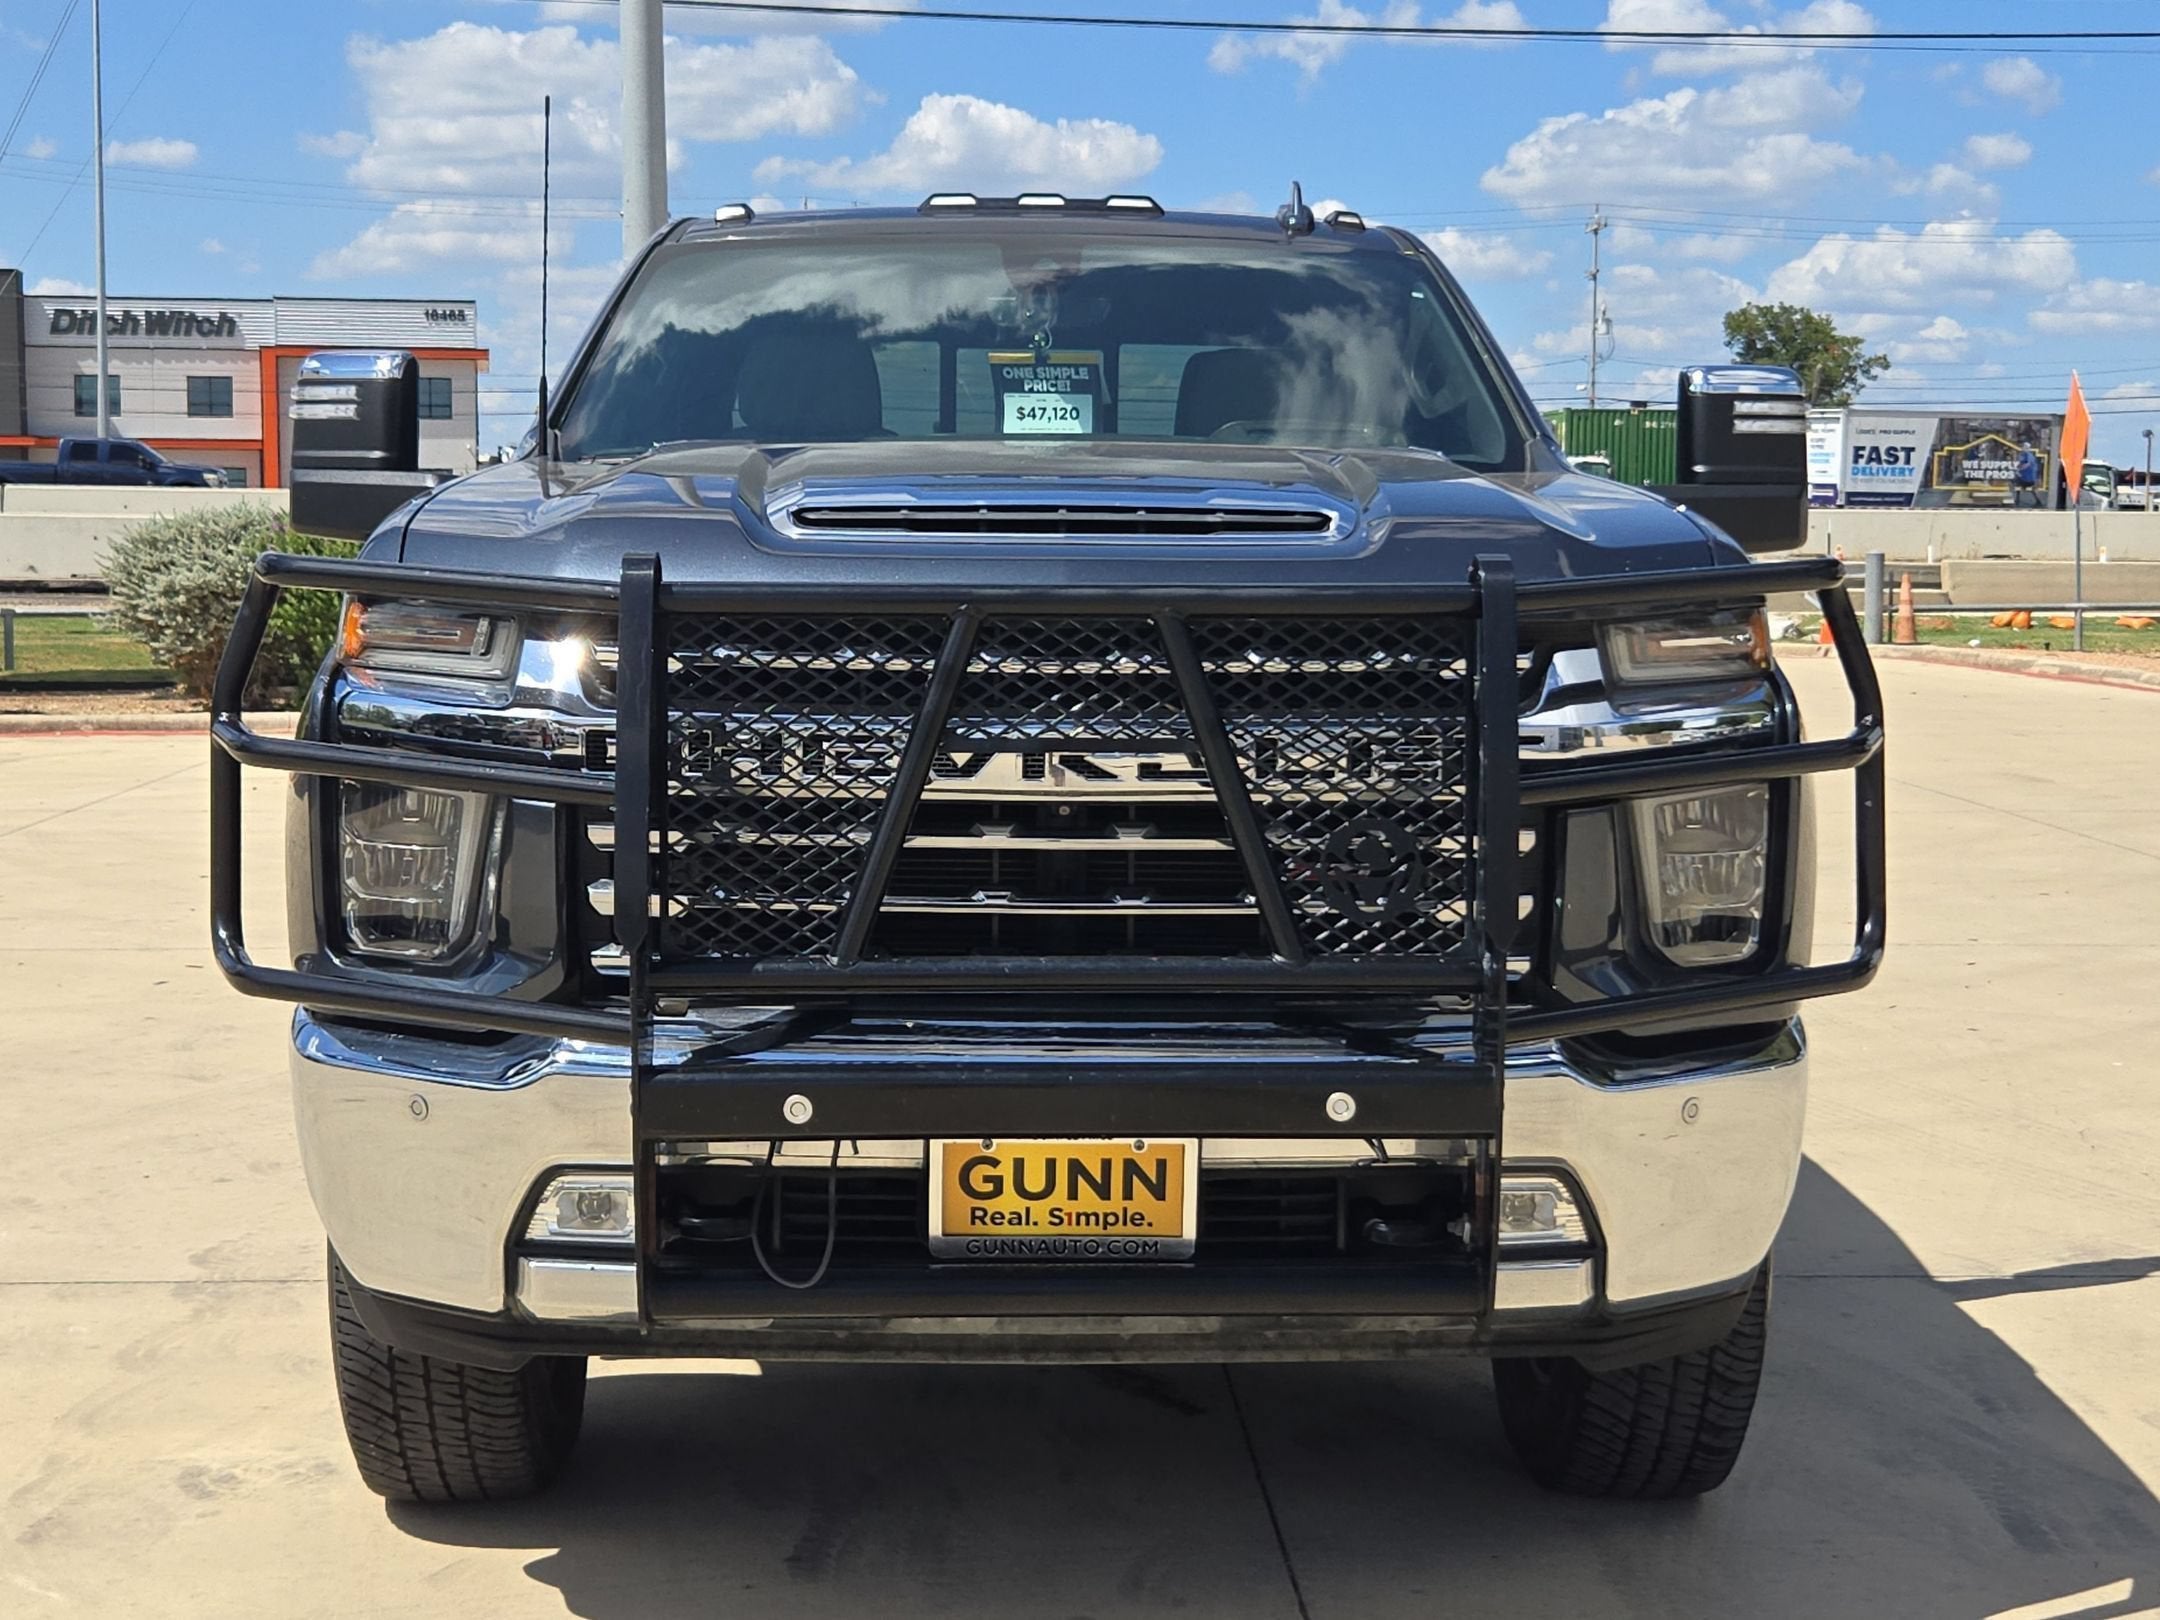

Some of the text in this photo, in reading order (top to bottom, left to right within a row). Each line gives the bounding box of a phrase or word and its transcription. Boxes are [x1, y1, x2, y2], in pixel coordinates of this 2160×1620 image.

[50, 308, 237, 338] Ditch Witch
[1002, 366, 1089, 380] ONE SIMPLE
[1023, 380, 1071, 392] PRICE!
[1016, 406, 1080, 424] $47,120
[1852, 446, 1916, 466] FAST
[1851, 466, 1915, 477] DELIVERY
[1962, 460, 2020, 470] WE SUPPLY
[1964, 470, 2015, 479] THE PROS
[958, 1155, 1167, 1201] GUNN
[969, 1206, 1038, 1227] Real.
[966, 1239, 1160, 1255] GUNNAUTO.COM
